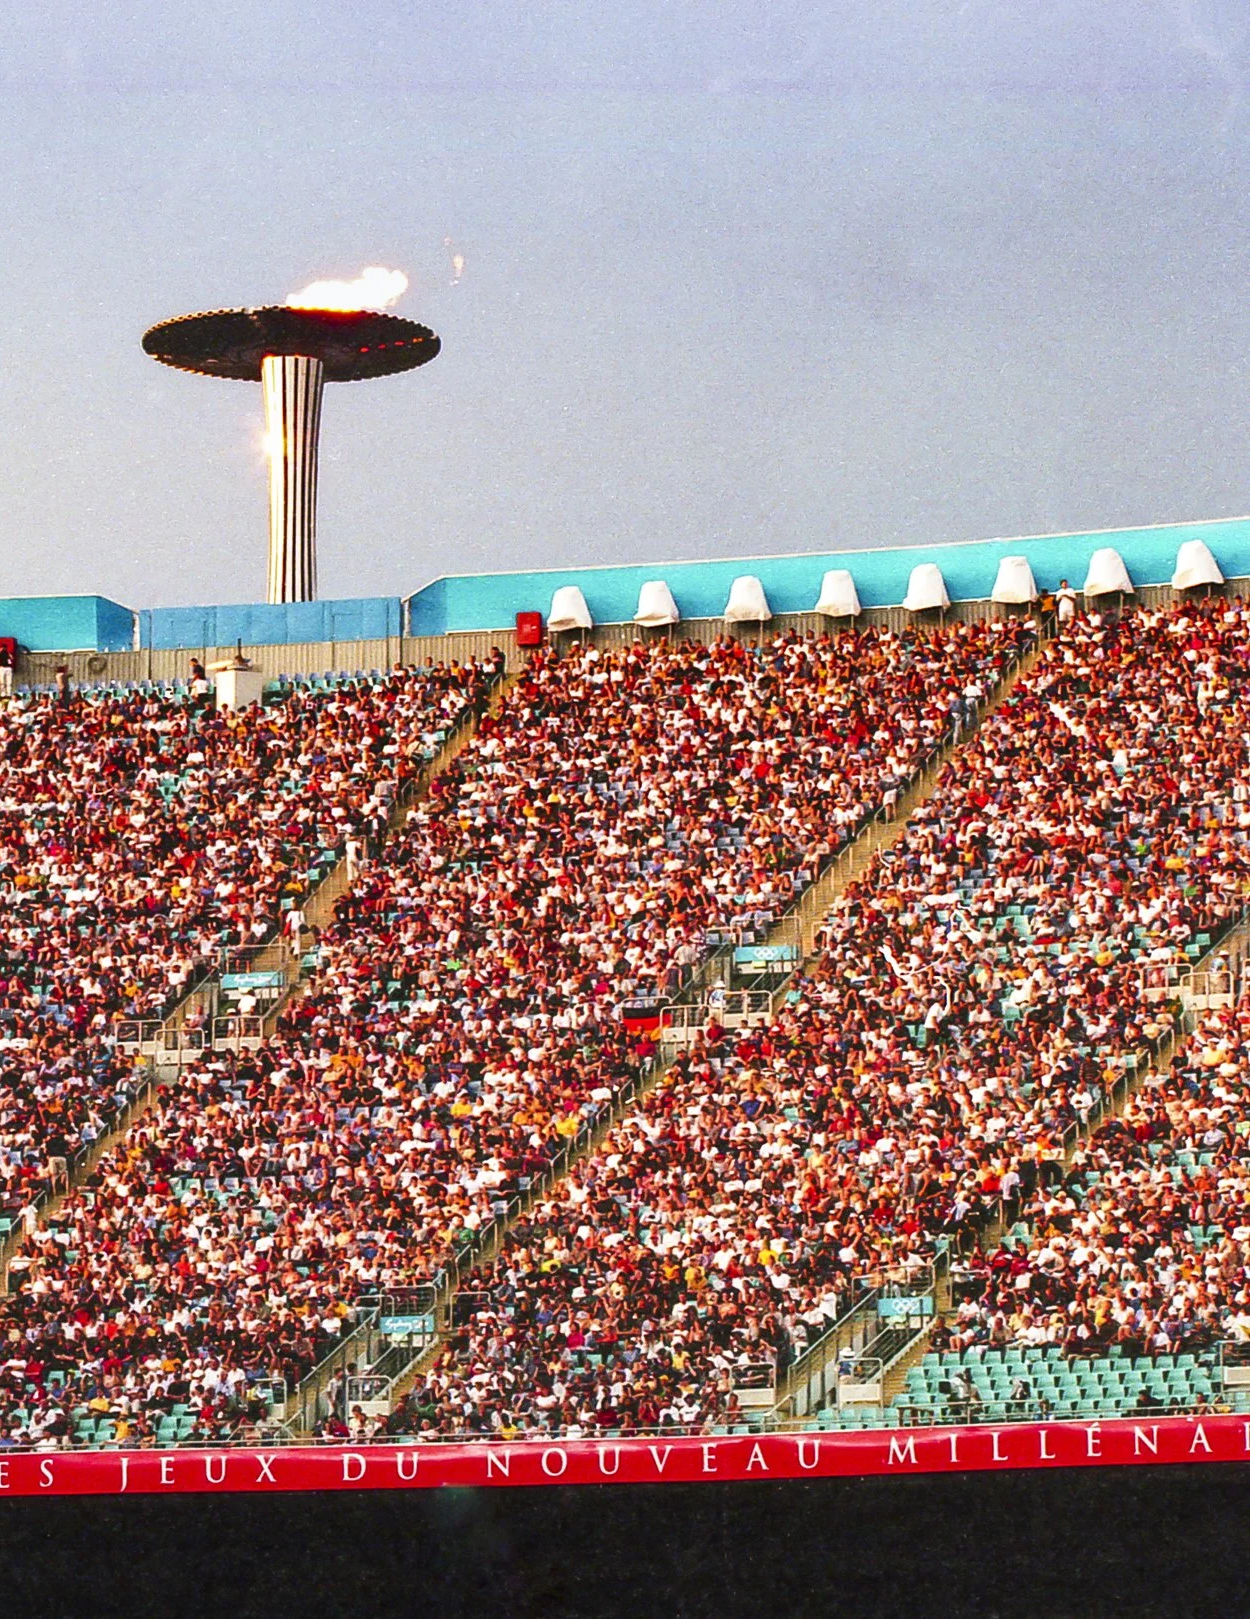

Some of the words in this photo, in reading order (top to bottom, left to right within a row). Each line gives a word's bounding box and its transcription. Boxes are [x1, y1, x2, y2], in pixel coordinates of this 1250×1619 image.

[119, 1454, 278, 1492] JEUX
[341, 1451, 421, 1481] DU
[486, 1439, 822, 1478] NOUVEAU
